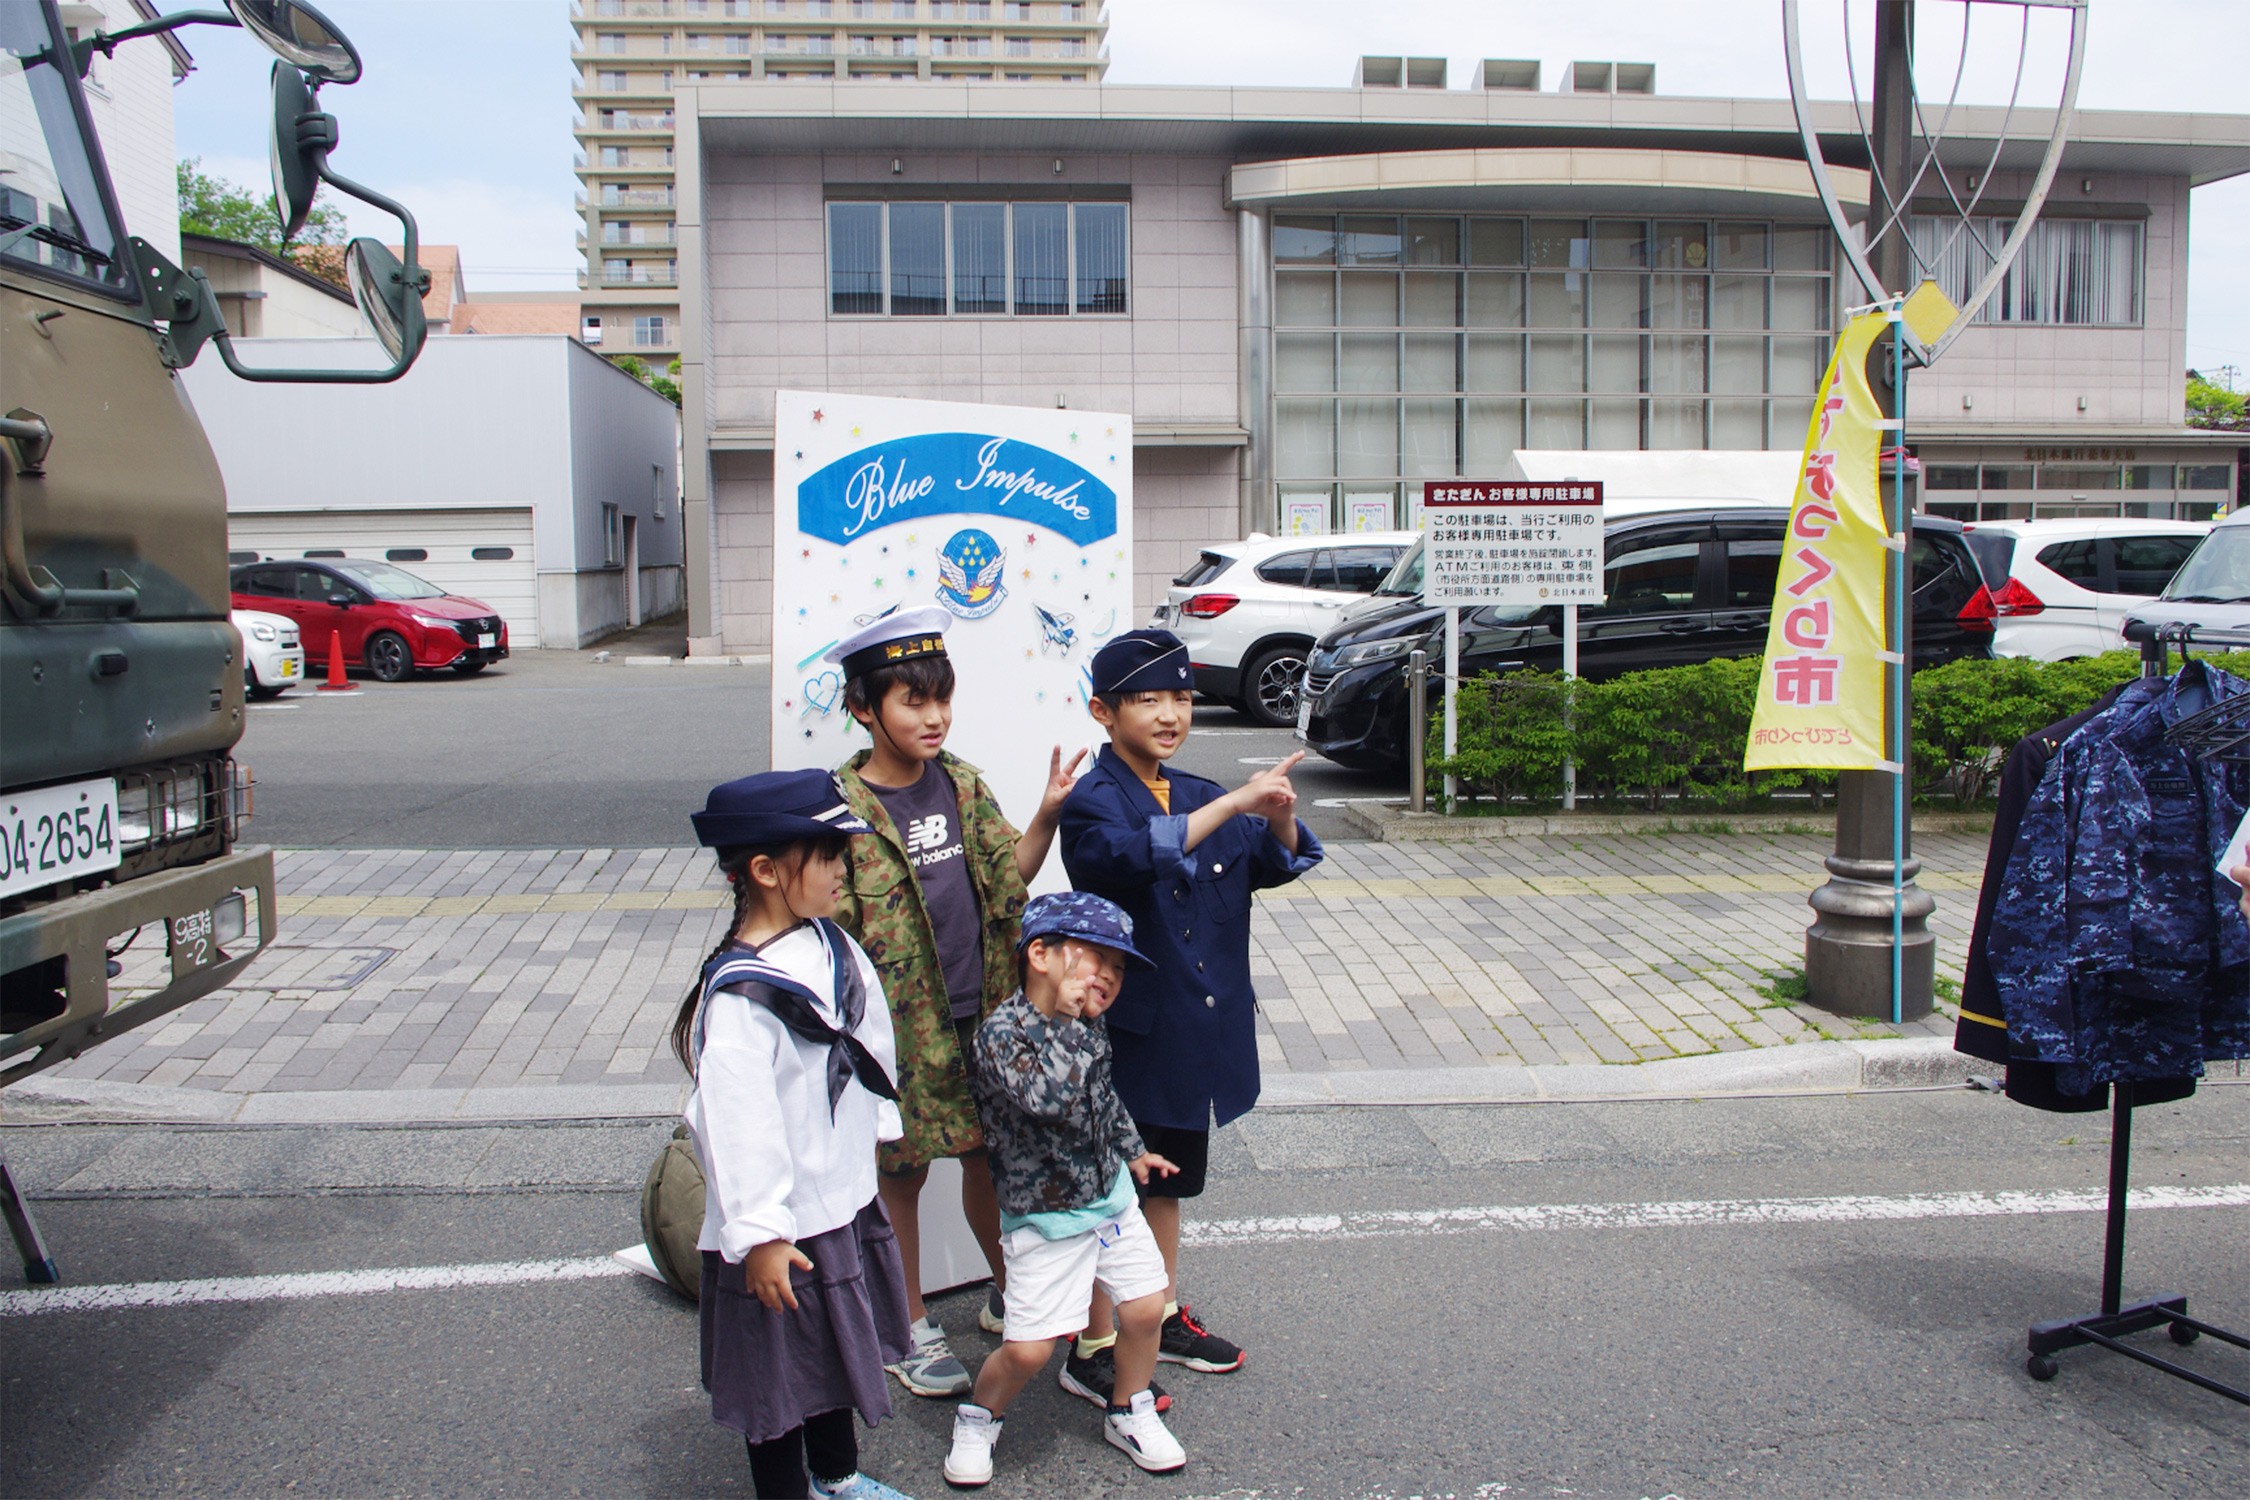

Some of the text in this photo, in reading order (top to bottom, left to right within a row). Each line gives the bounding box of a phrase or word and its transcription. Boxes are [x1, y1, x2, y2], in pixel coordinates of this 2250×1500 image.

[843, 437, 1091, 535] Blue Impulse
[1433, 487, 1595, 501] きたぎん お客様専用駐車場
[1434, 513, 1595, 526] この駐車場は、当行ご利用の
[1433, 529, 1562, 541] お客様専用駐車場です。
[921, 843, 964, 865] balanc
